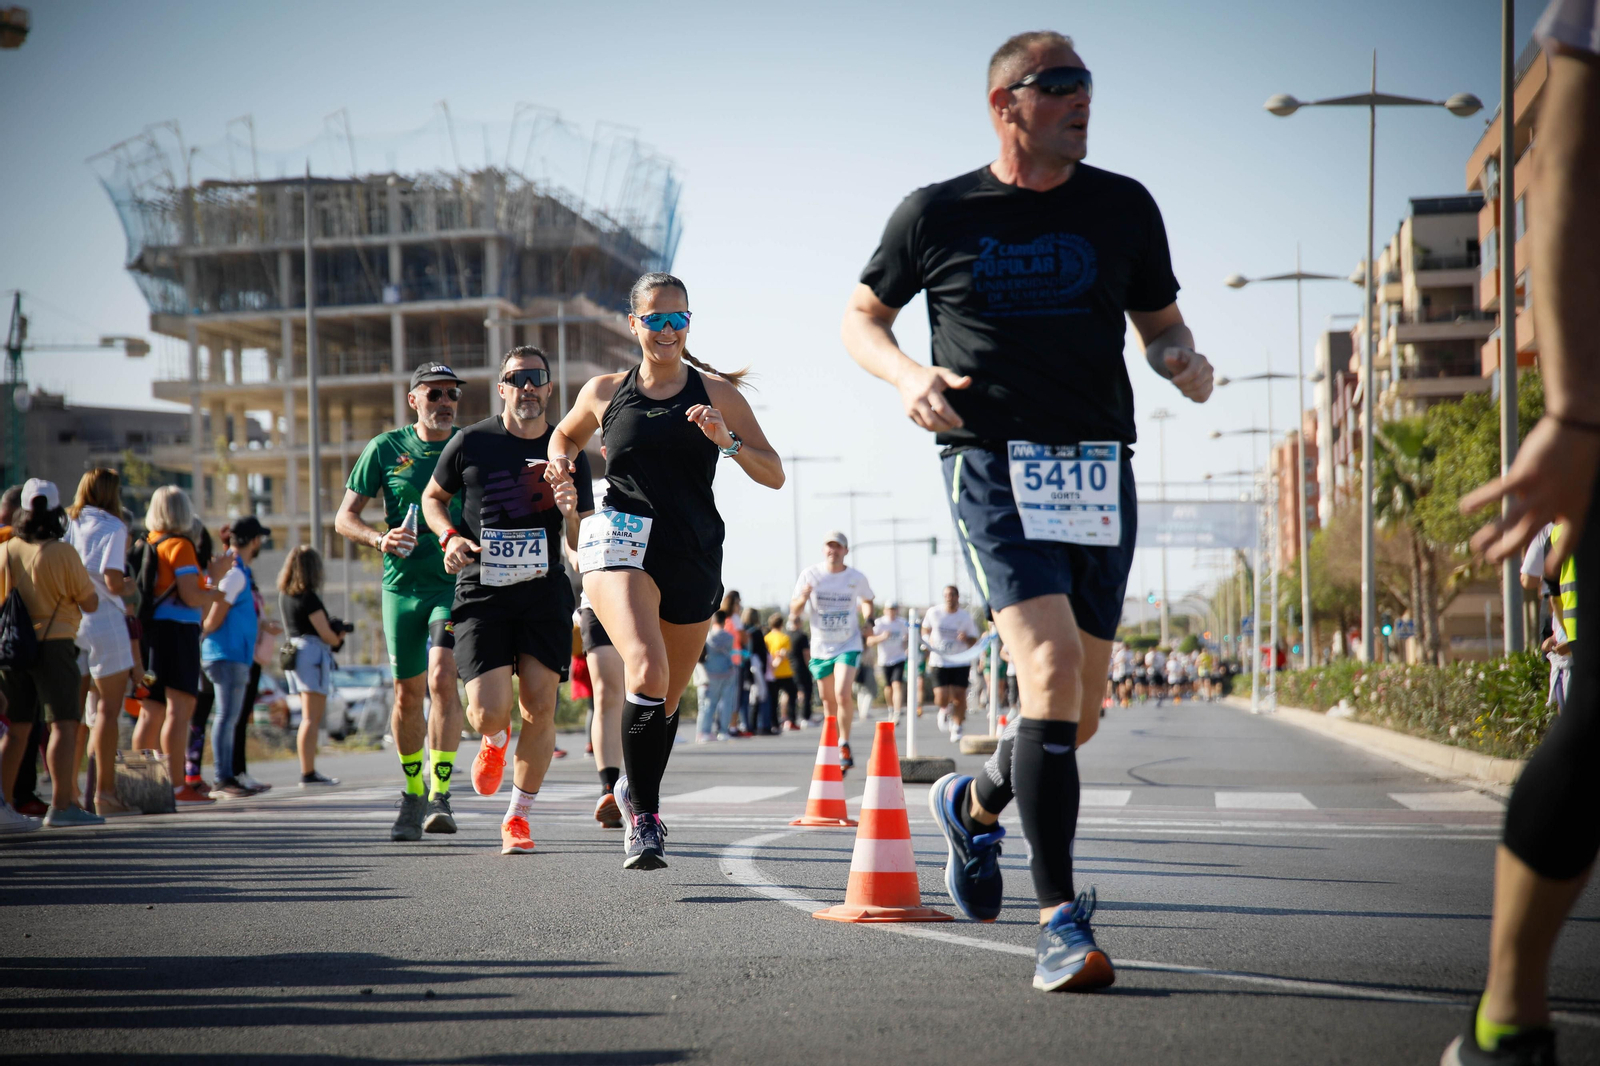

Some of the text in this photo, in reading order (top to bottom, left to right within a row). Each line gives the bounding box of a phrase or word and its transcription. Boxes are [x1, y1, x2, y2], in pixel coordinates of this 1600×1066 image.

[998, 243, 1056, 257] CARRERA
[972, 256, 1056, 279] POPULAR
[1024, 461, 1107, 491] 5410
[1051, 491, 1081, 500] GORTS
[611, 530, 633, 539] NAIRA
[488, 539, 542, 558] 5874
